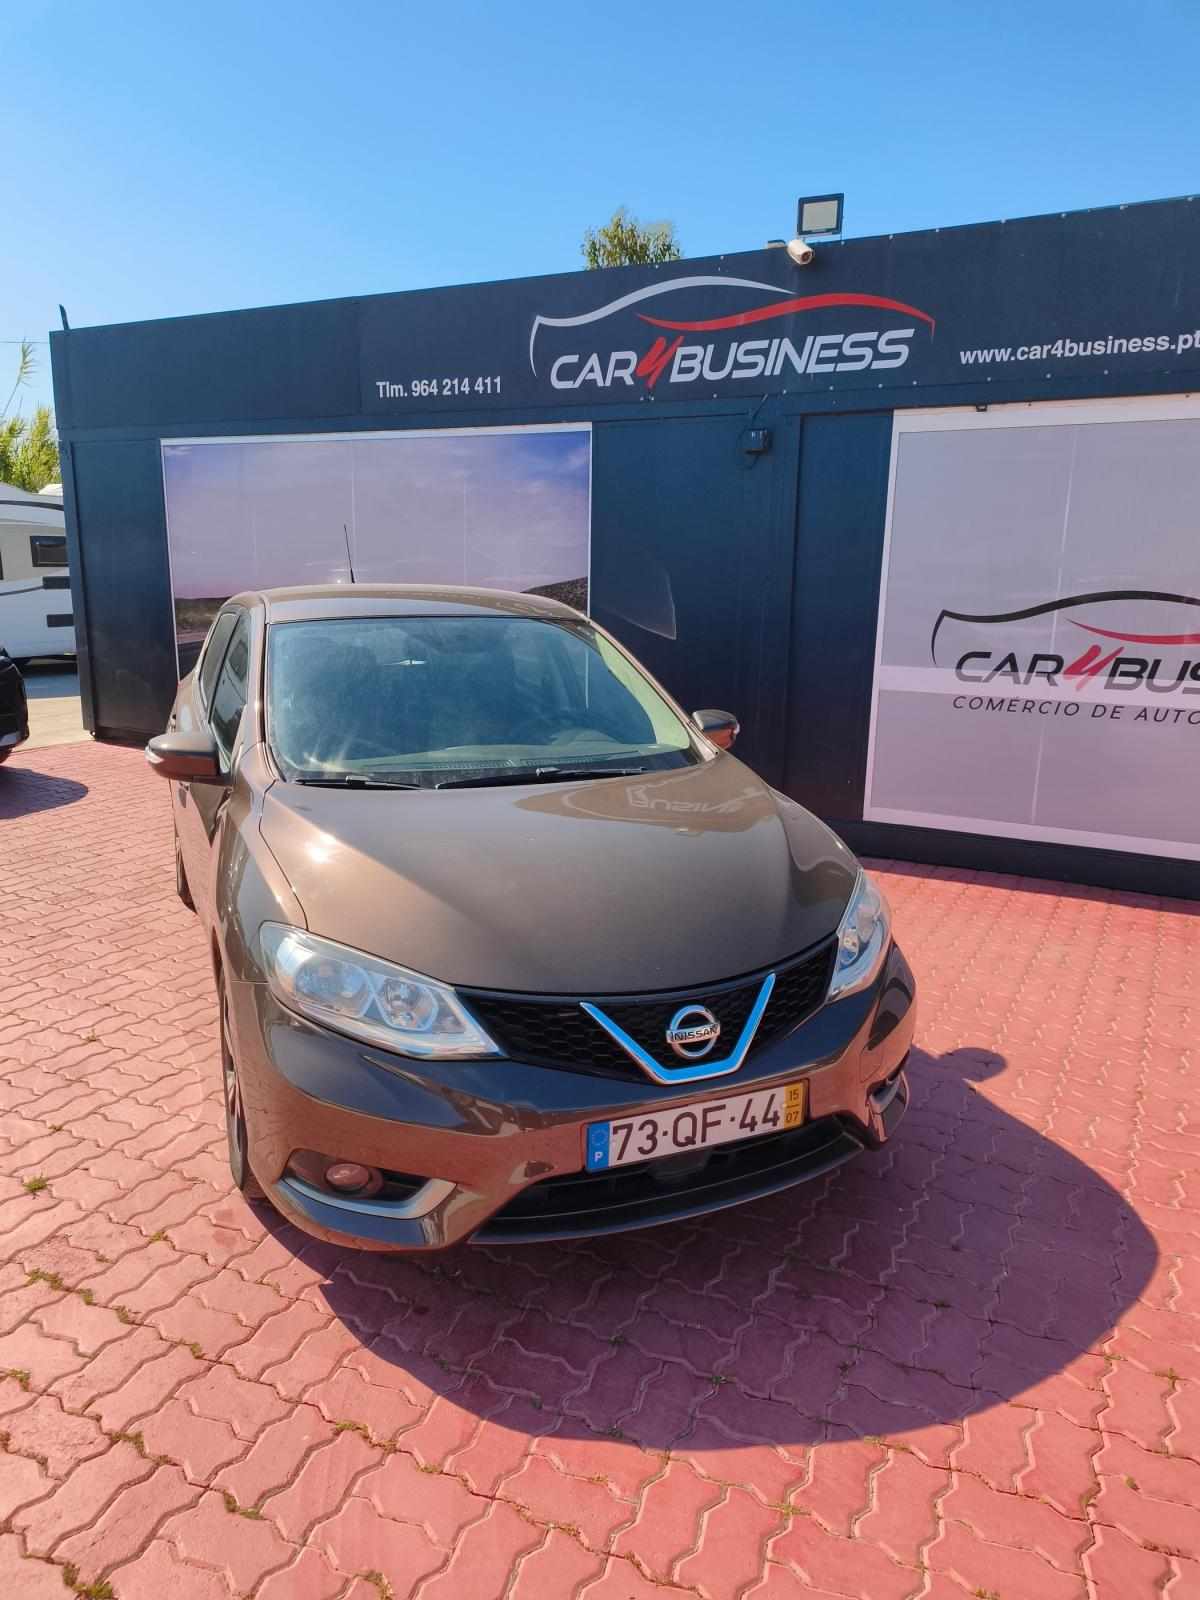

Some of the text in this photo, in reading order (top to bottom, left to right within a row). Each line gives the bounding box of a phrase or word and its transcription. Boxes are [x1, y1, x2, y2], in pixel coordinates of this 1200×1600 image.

[959, 330, 1200, 364] www.car4business.pt
[376, 375, 501, 398] Tlm. 964 214 411
[1091, 704, 1125, 719] DE
[670, 1023, 719, 1042] NISSAN
[788, 1088, 800, 1101] 15
[785, 1110, 800, 1123] 07
[594, 1151, 603, 1163] P
